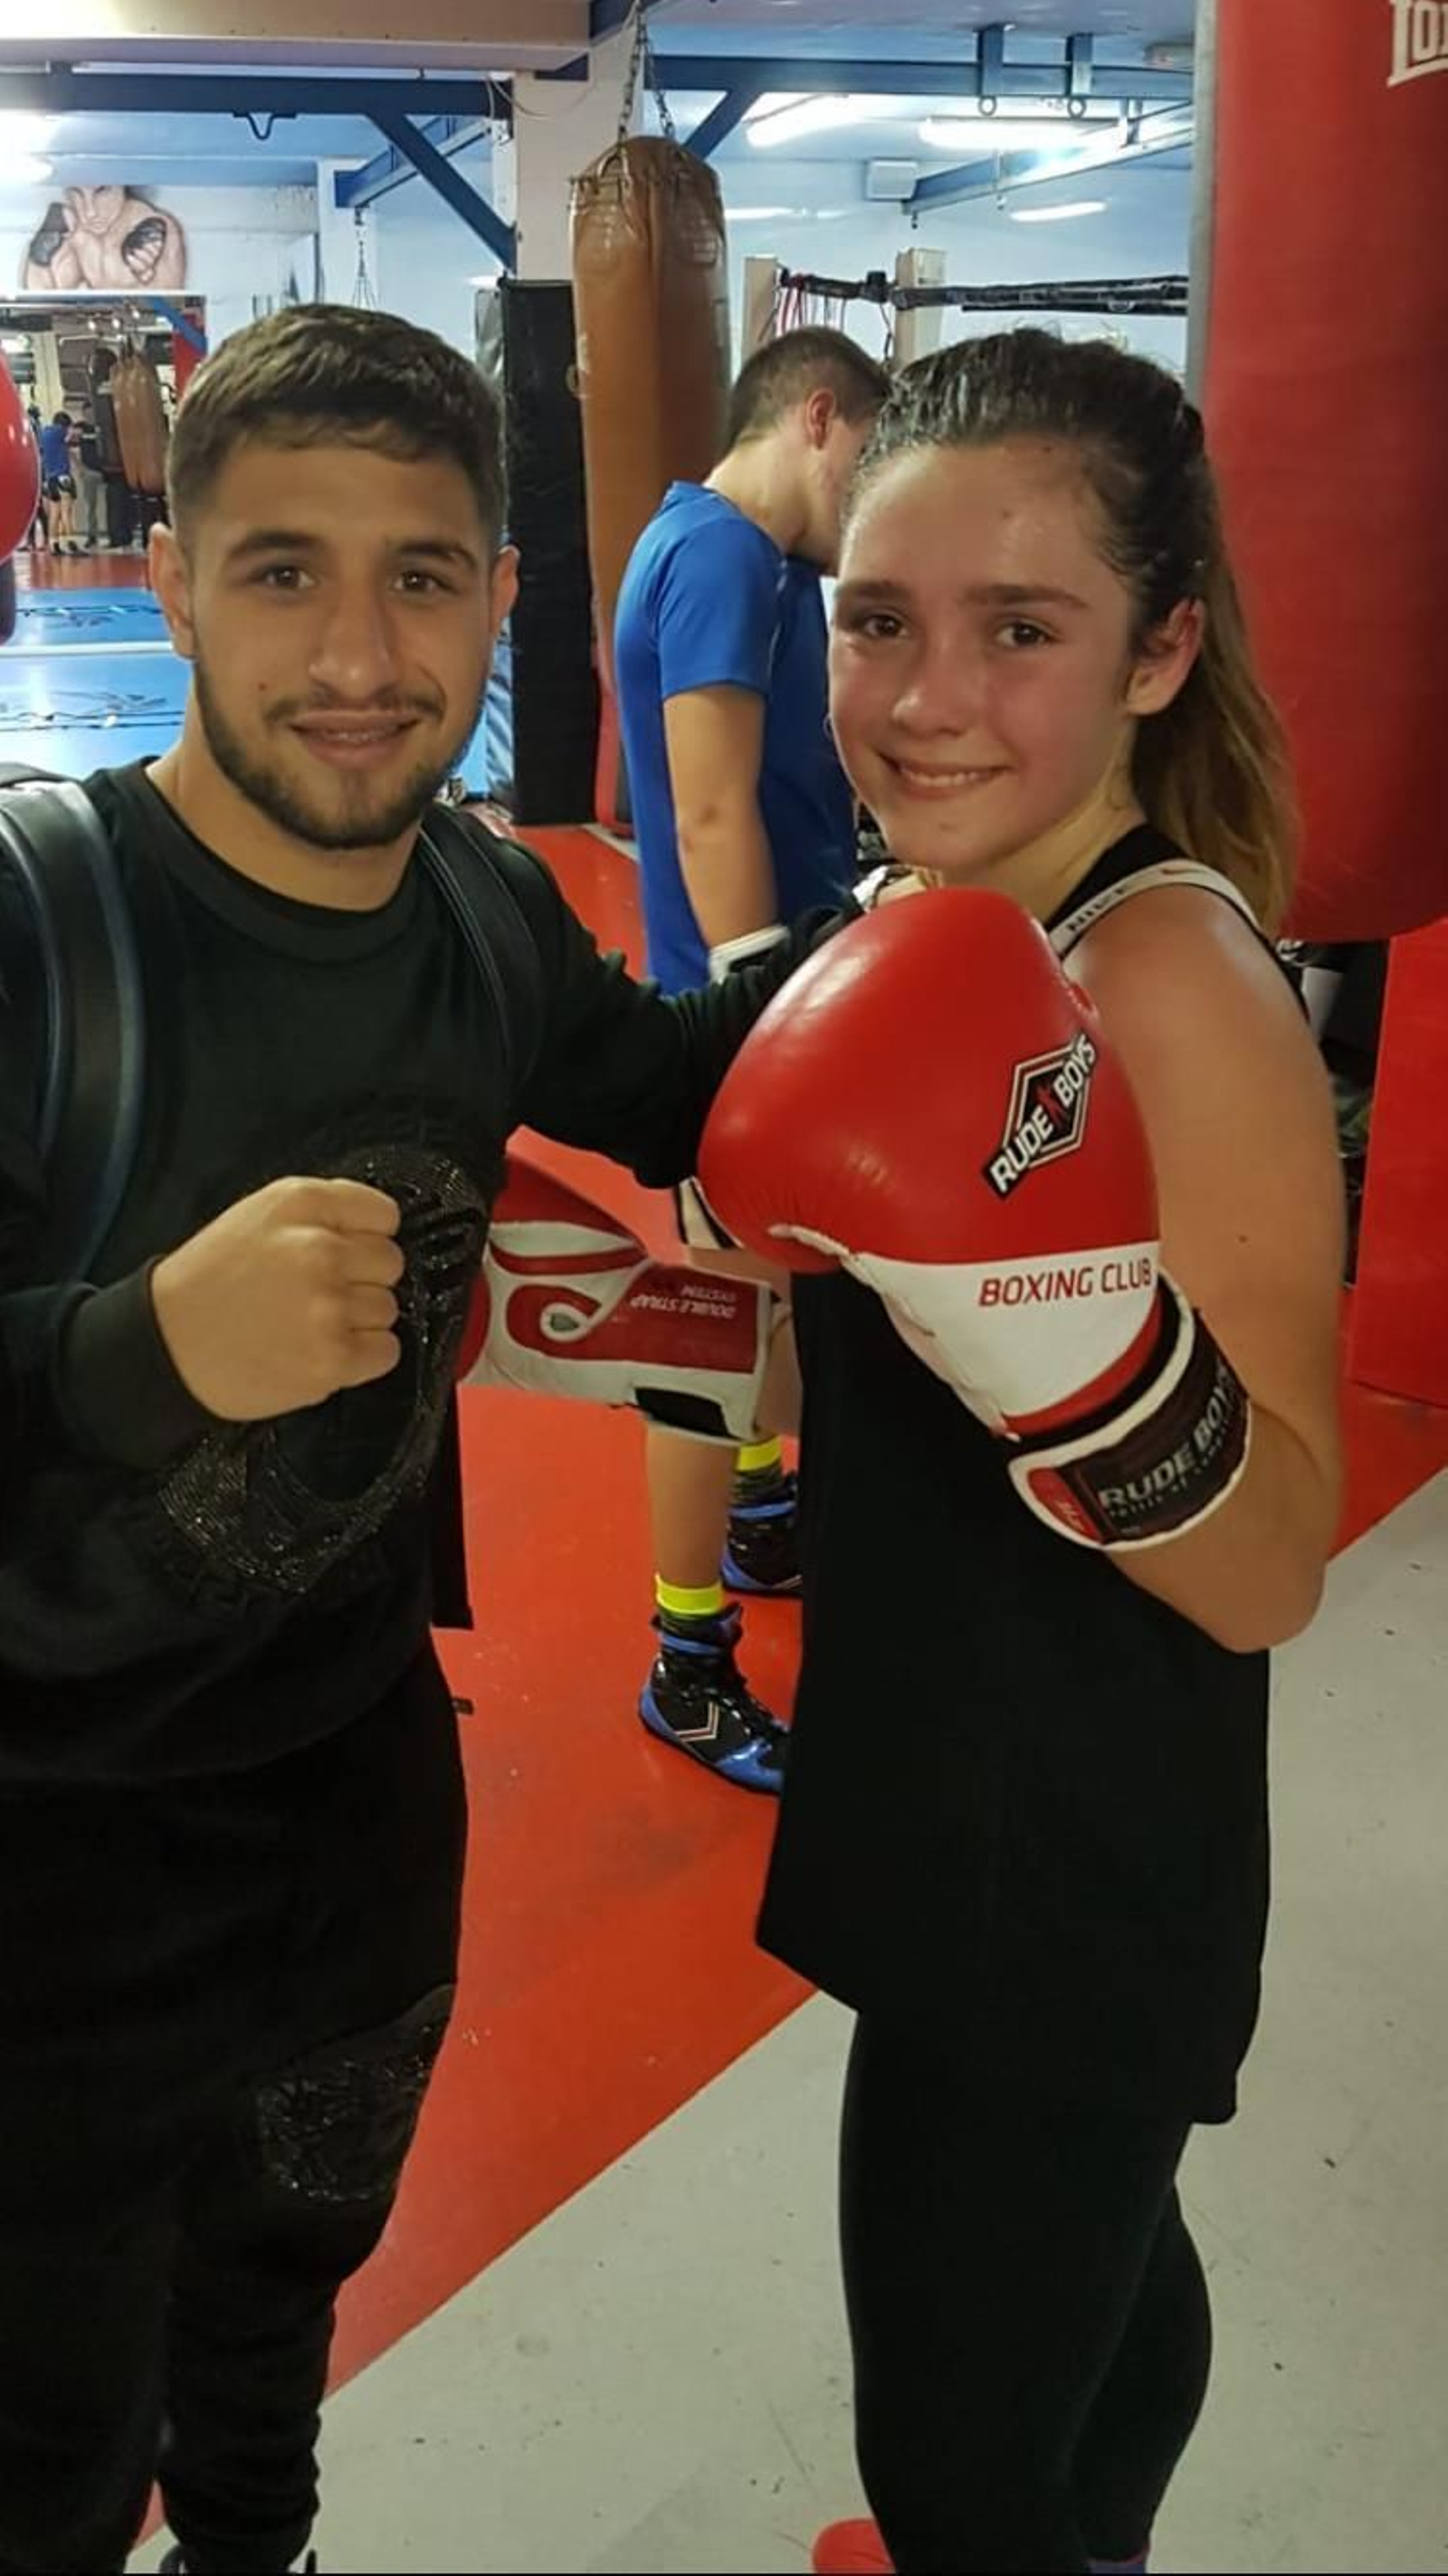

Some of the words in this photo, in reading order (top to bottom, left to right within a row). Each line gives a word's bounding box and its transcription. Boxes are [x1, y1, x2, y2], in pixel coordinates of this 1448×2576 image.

[989, 1106, 1054, 1193] RUDE
[1053, 1034, 1096, 1108] BOYS
[630, 1294, 680, 1312] STRAP
[979, 1267, 1093, 1306] BOXING
[1100, 1257, 1151, 1293] CLUB
[1097, 1442, 1196, 1507] RUDE
